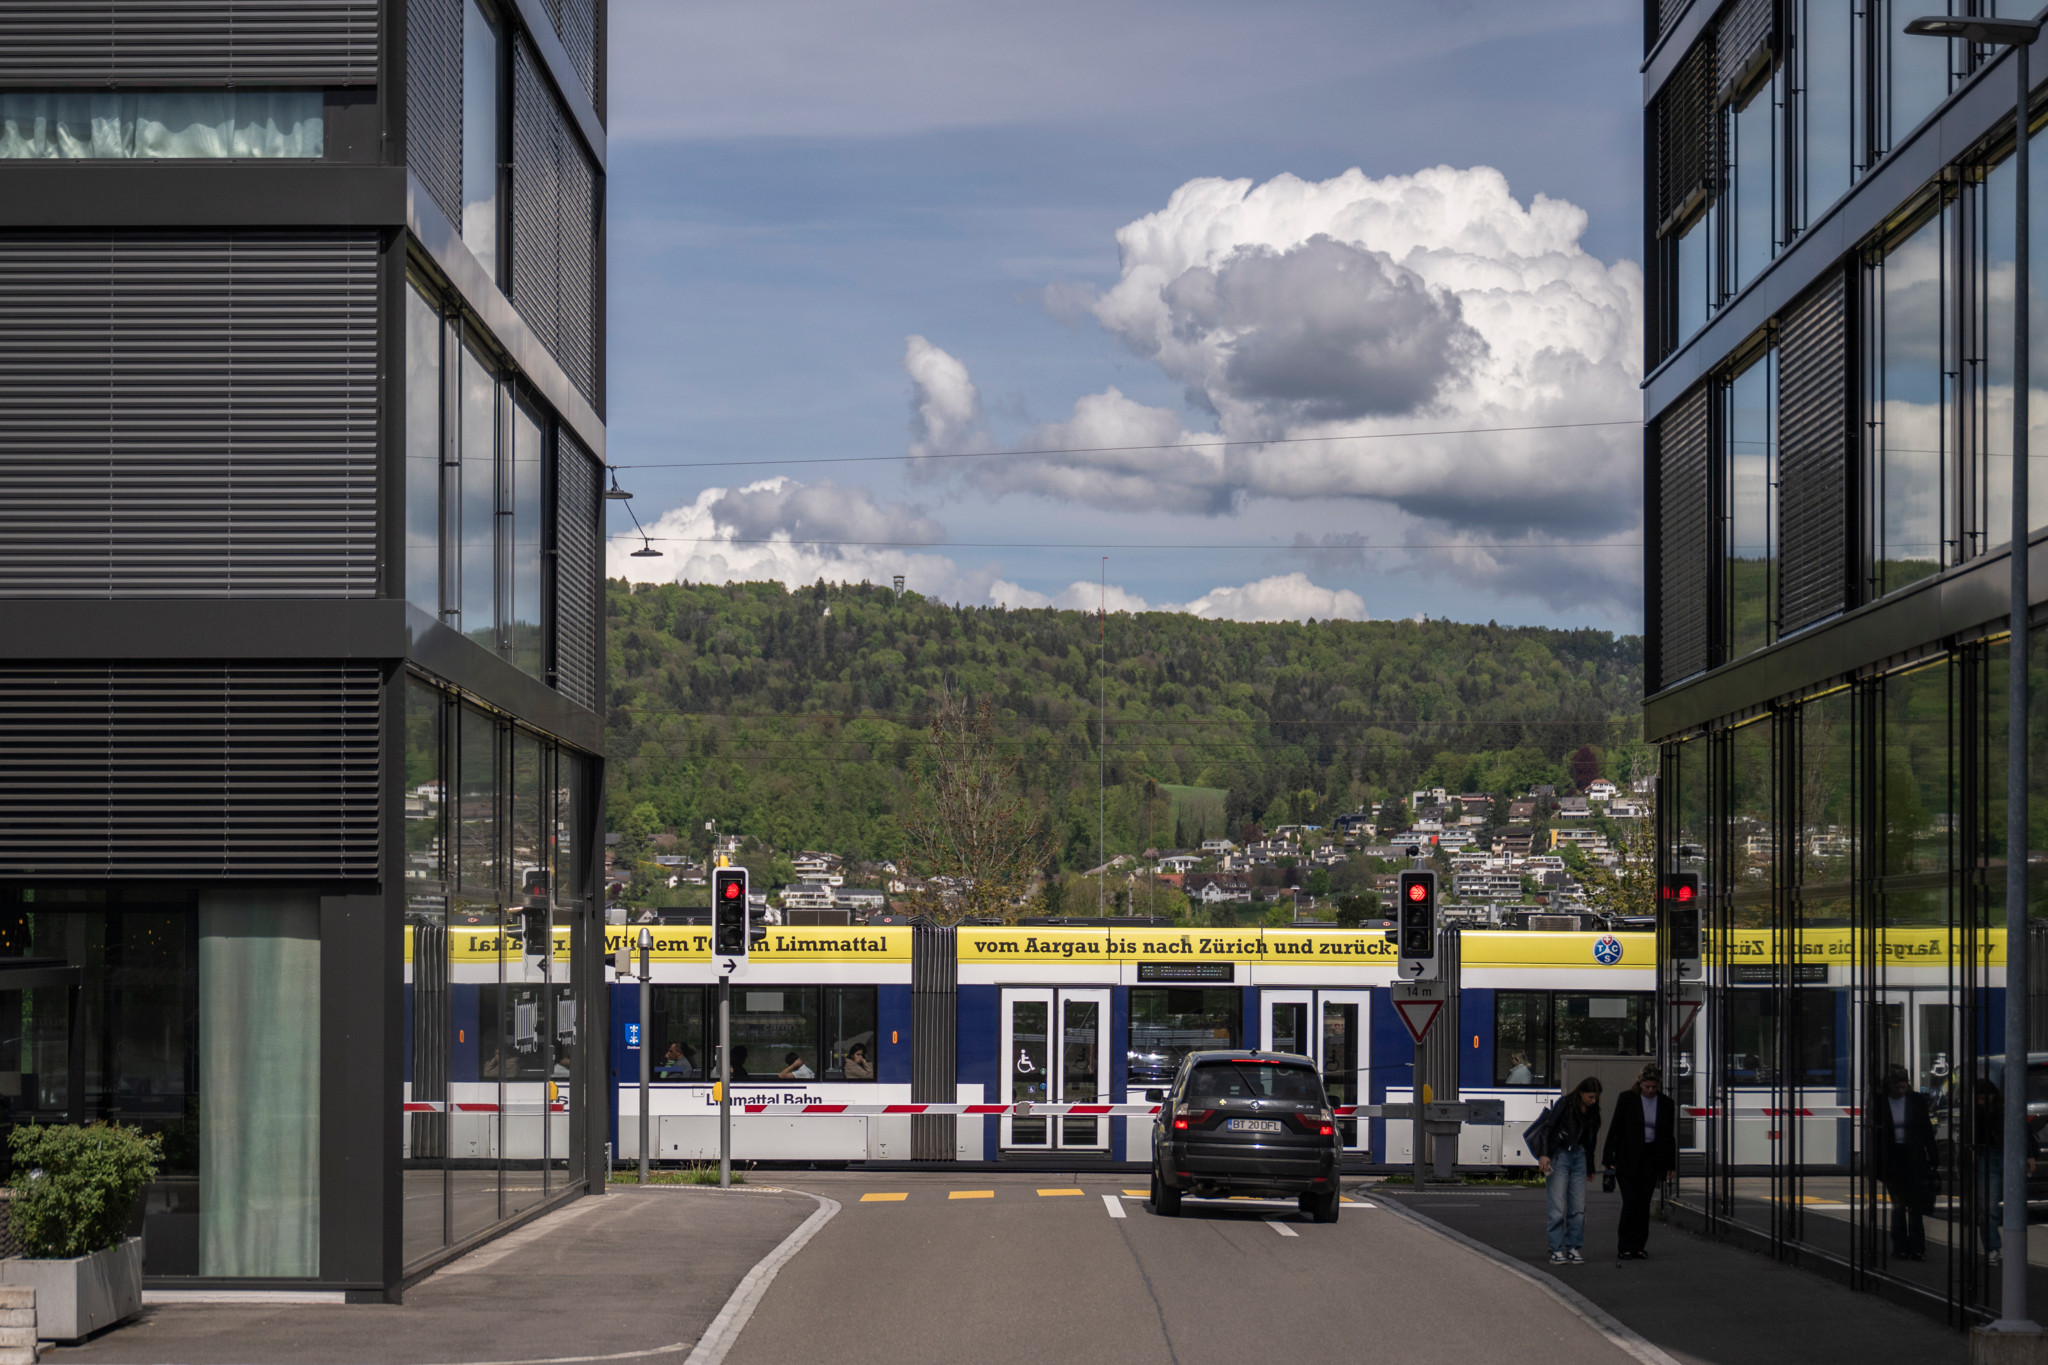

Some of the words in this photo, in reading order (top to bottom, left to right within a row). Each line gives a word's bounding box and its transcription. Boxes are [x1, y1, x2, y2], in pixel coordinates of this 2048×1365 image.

[604, 936, 637, 951] Mit
[776, 936, 887, 952] Limmattal
[974, 940, 1020, 953] vom
[1024, 937, 1100, 957] Aargau
[1106, 938, 1137, 954] bis
[1142, 938, 1193, 954] nach
[1199, 938, 1268, 954] Zürich
[1273, 939, 1314, 955] und
[1319, 939, 1398, 955] zurück.
[1407, 986, 1418, 997] 14
[1422, 988, 1432, 997] m
[706, 1093, 779, 1106] Lmattal
[784, 1093, 822, 1105] Bahn
[1233, 1120, 1246, 1129] BT
[1248, 1121, 1259, 1130] 20
[1260, 1121, 1279, 1131] DFL
